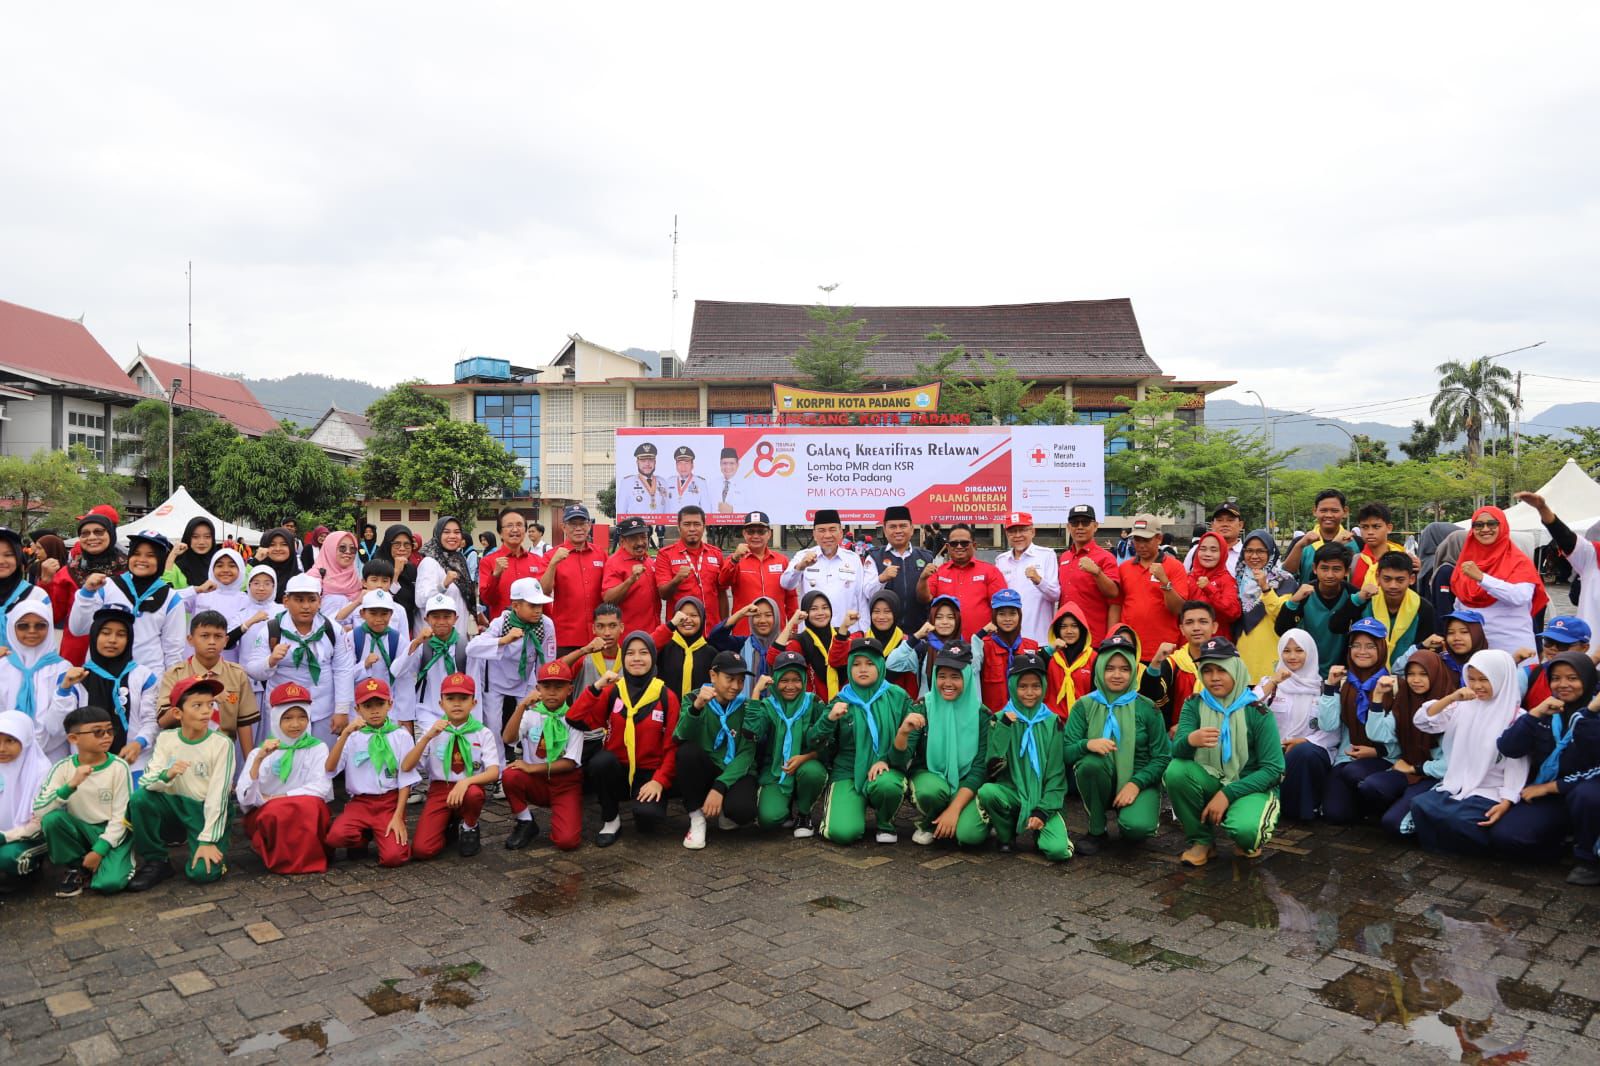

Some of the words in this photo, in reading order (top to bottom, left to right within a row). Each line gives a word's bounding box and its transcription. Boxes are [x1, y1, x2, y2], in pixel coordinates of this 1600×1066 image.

[796, 398, 835, 408] KORPRI
[838, 398, 865, 408] KOTA
[868, 398, 911, 408] PADANG
[860, 414, 899, 425] KOTA
[911, 413, 971, 425] PADANG
[1053, 443, 1076, 451] Palang
[807, 461, 843, 471] Lomba
[845, 461, 870, 471] PMR
[872, 461, 892, 471] dan
[894, 461, 915, 471] KSR
[826, 473, 850, 482] Kota
[852, 473, 893, 483] Padang
[807, 488, 826, 497] PMI
[829, 488, 858, 497] KOTA
[860, 488, 906, 497] PADANG
[929, 493, 970, 502] PALANG
[972, 493, 1007, 502] MERAH
[952, 503, 1007, 512] INDONESIA
